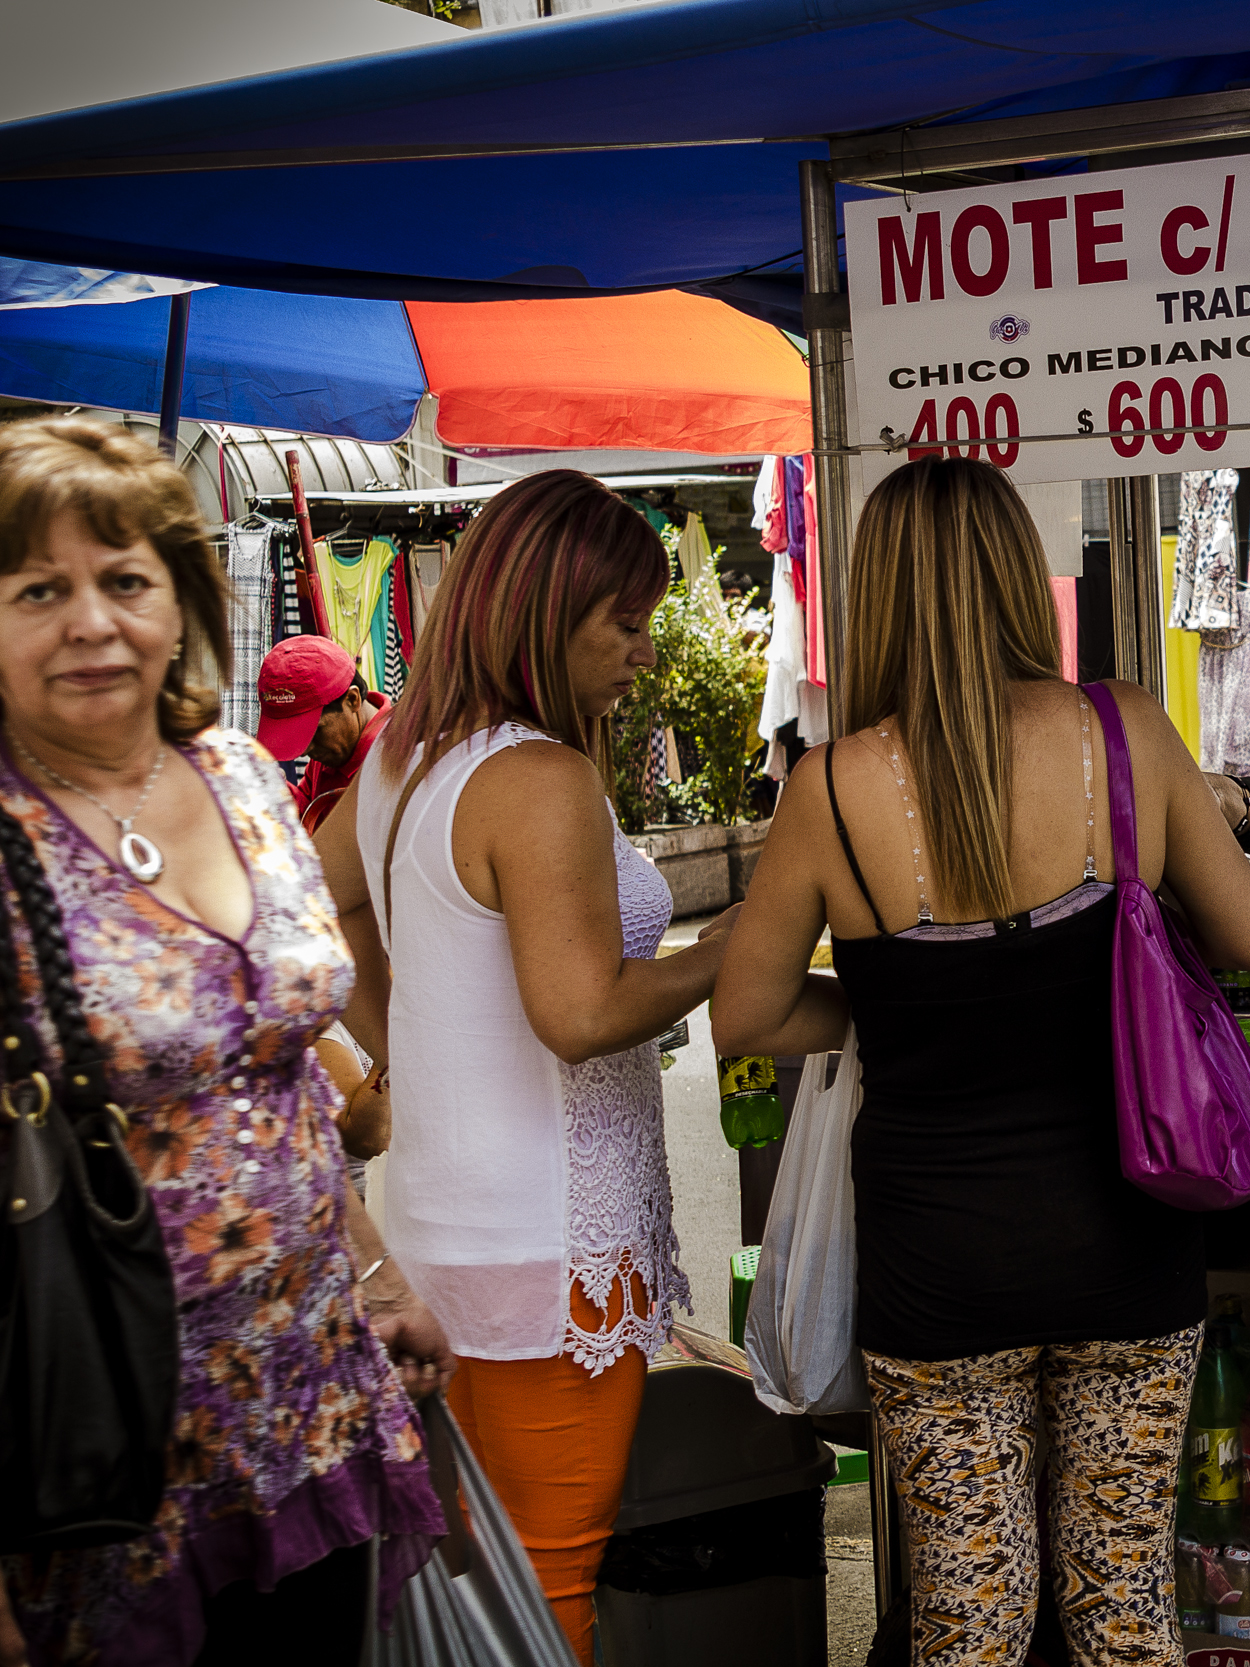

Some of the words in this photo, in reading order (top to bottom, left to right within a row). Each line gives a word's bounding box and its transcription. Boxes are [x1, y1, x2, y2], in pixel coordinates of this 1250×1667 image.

[877, 189, 1129, 306] MOTE
[1160, 174, 1236, 276] c/
[888, 357, 1031, 390] CHICO
[907, 392, 1021, 469] 400
[1077, 408, 1094, 435] $
[1107, 372, 1229, 459] 600
